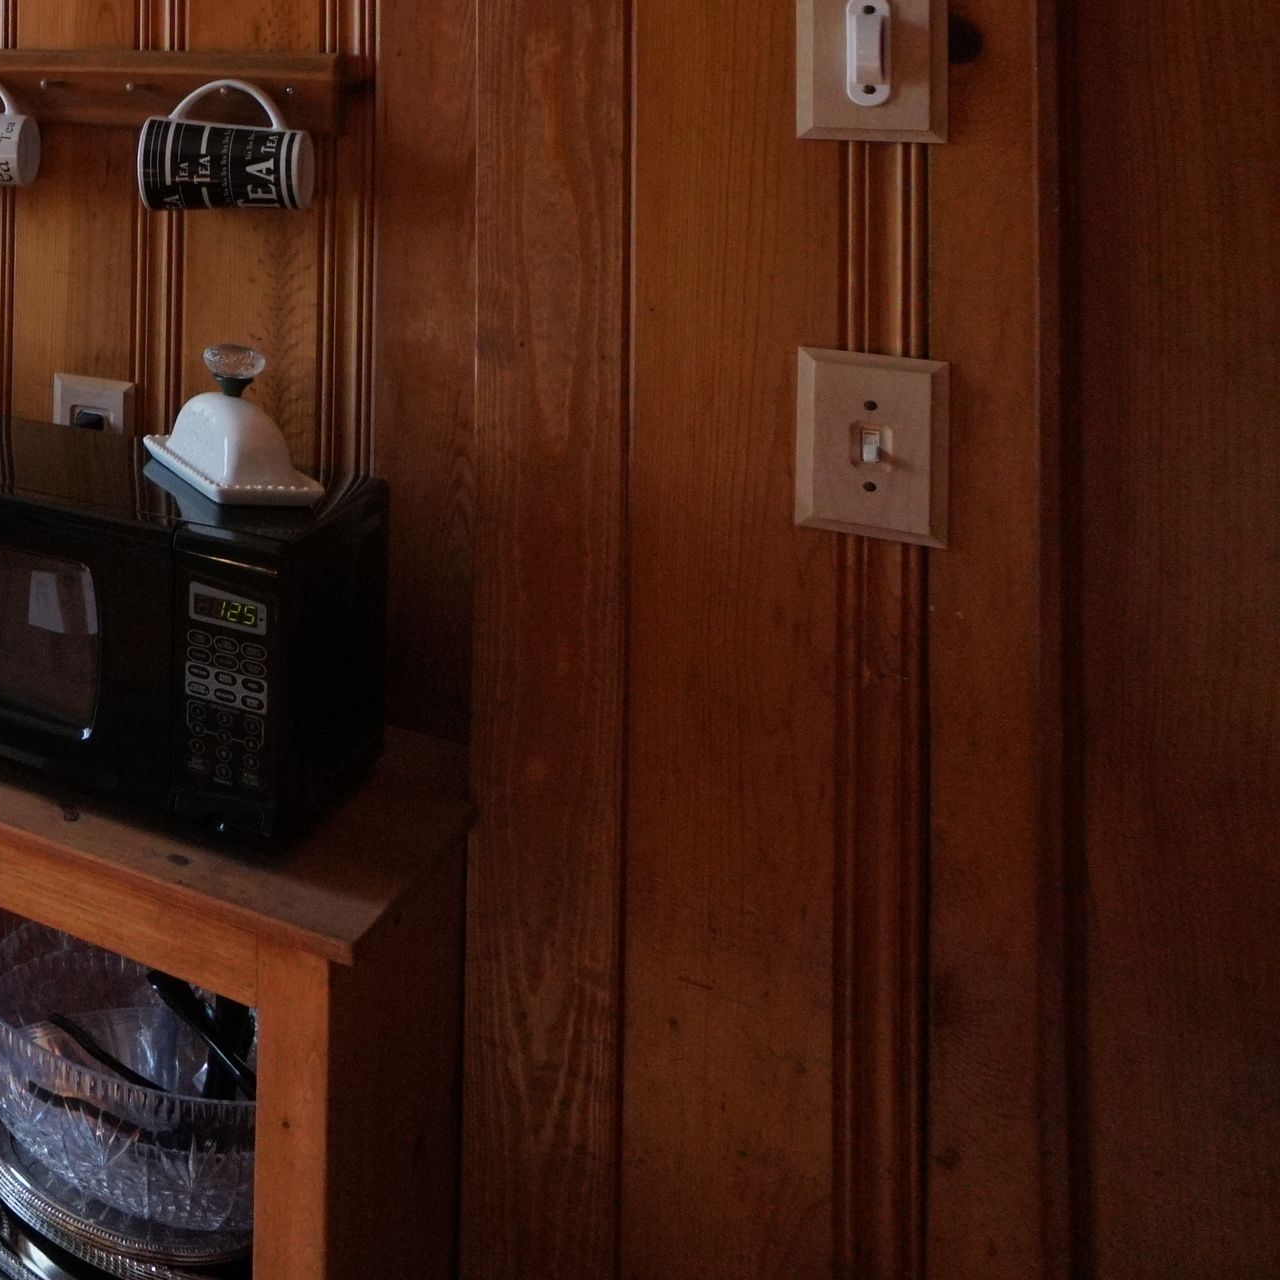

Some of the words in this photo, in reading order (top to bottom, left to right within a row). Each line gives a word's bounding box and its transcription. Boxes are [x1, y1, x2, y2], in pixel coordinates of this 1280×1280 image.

[0, 121, 15, 142] Tea
[176, 162, 189, 182] TEA
[194, 156, 211, 184] TEA
[237, 157, 280, 208] TEA
